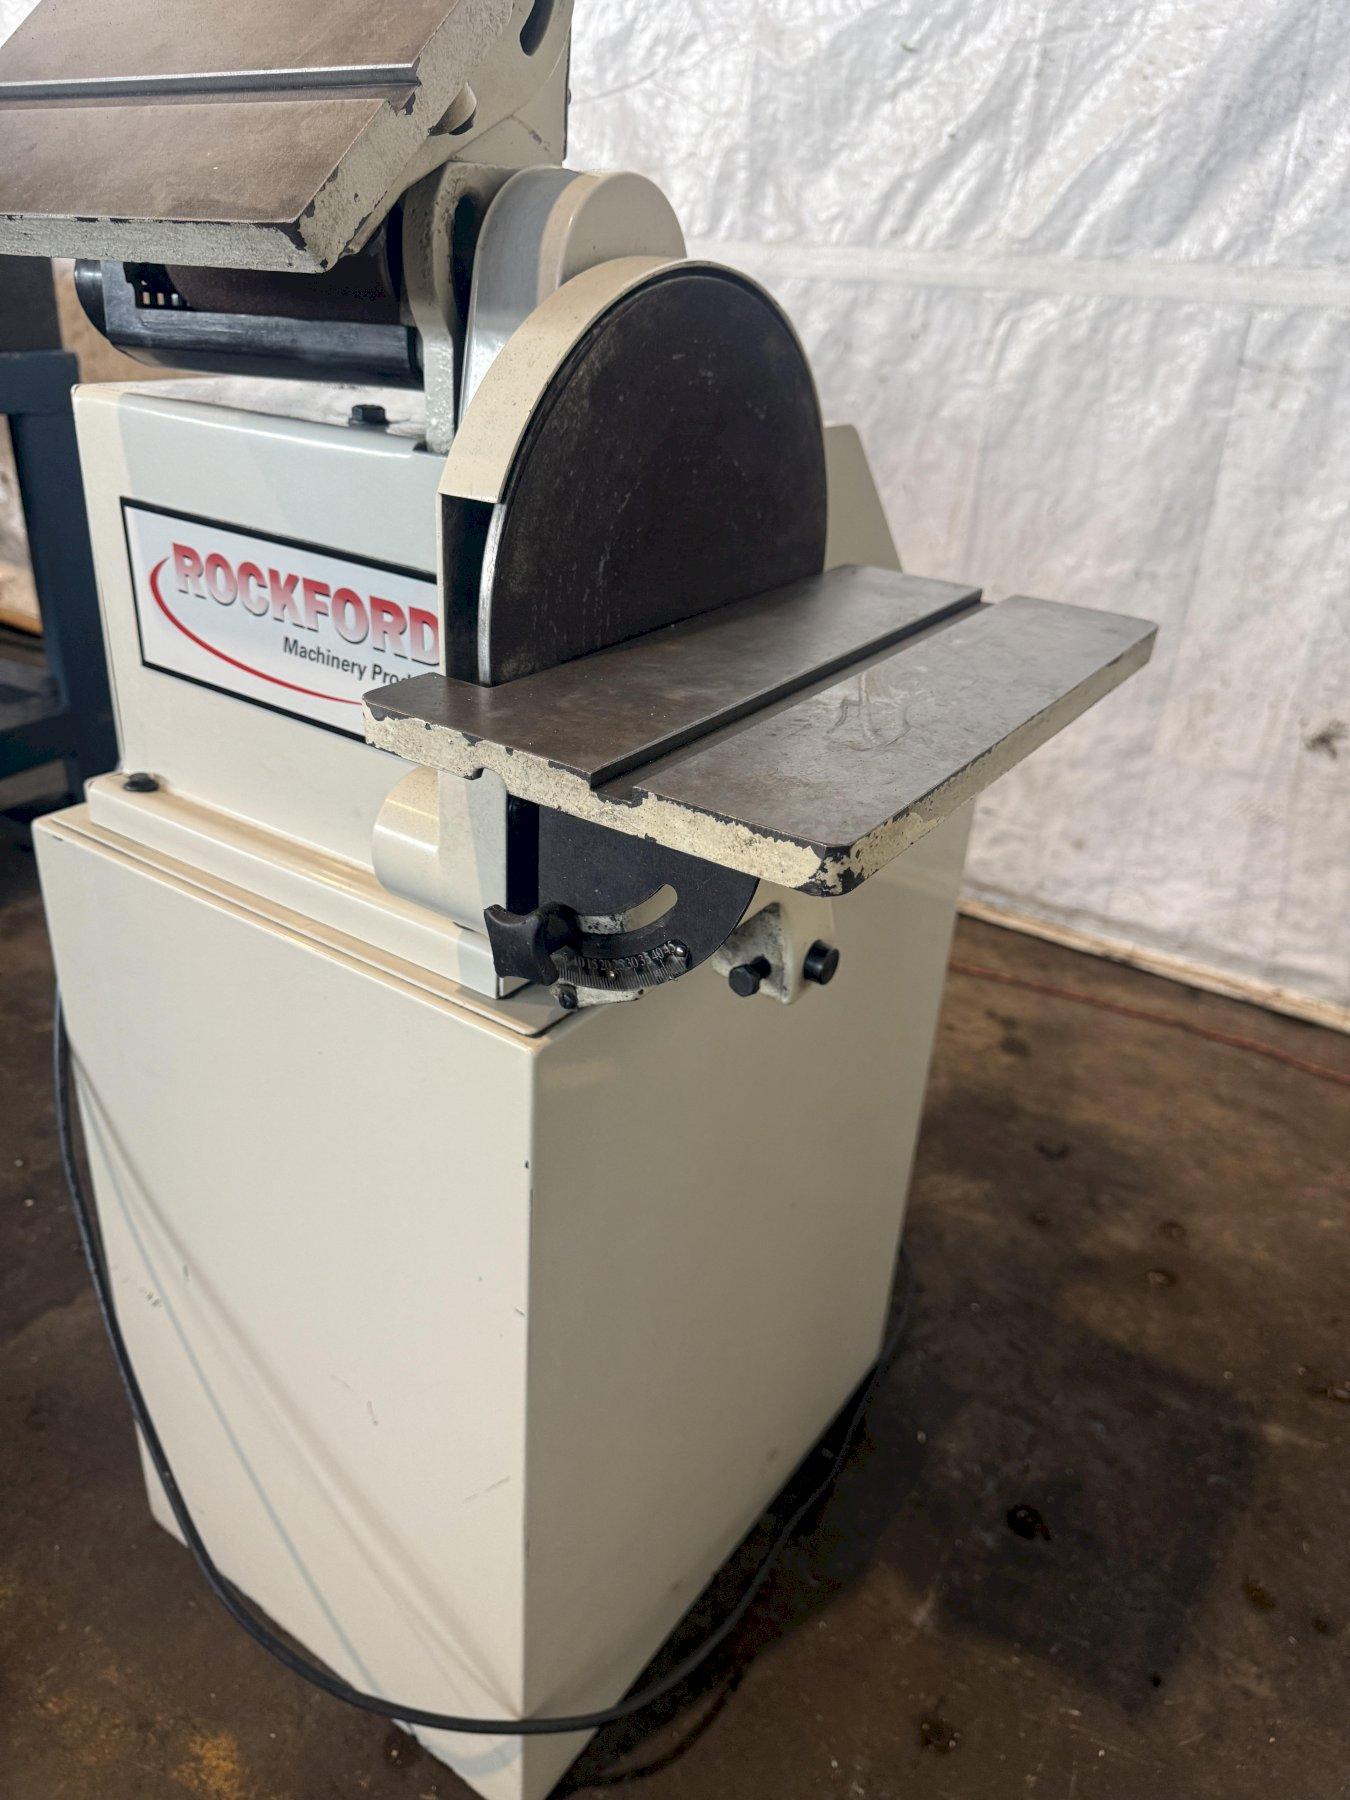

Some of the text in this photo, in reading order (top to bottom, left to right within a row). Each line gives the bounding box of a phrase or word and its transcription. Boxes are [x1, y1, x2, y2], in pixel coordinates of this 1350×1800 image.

[172, 542, 440, 667] ROCKFORD
[283, 636, 367, 682] Machinery
[626, 957, 638, 969] 30
[652, 947, 664, 960] 40
